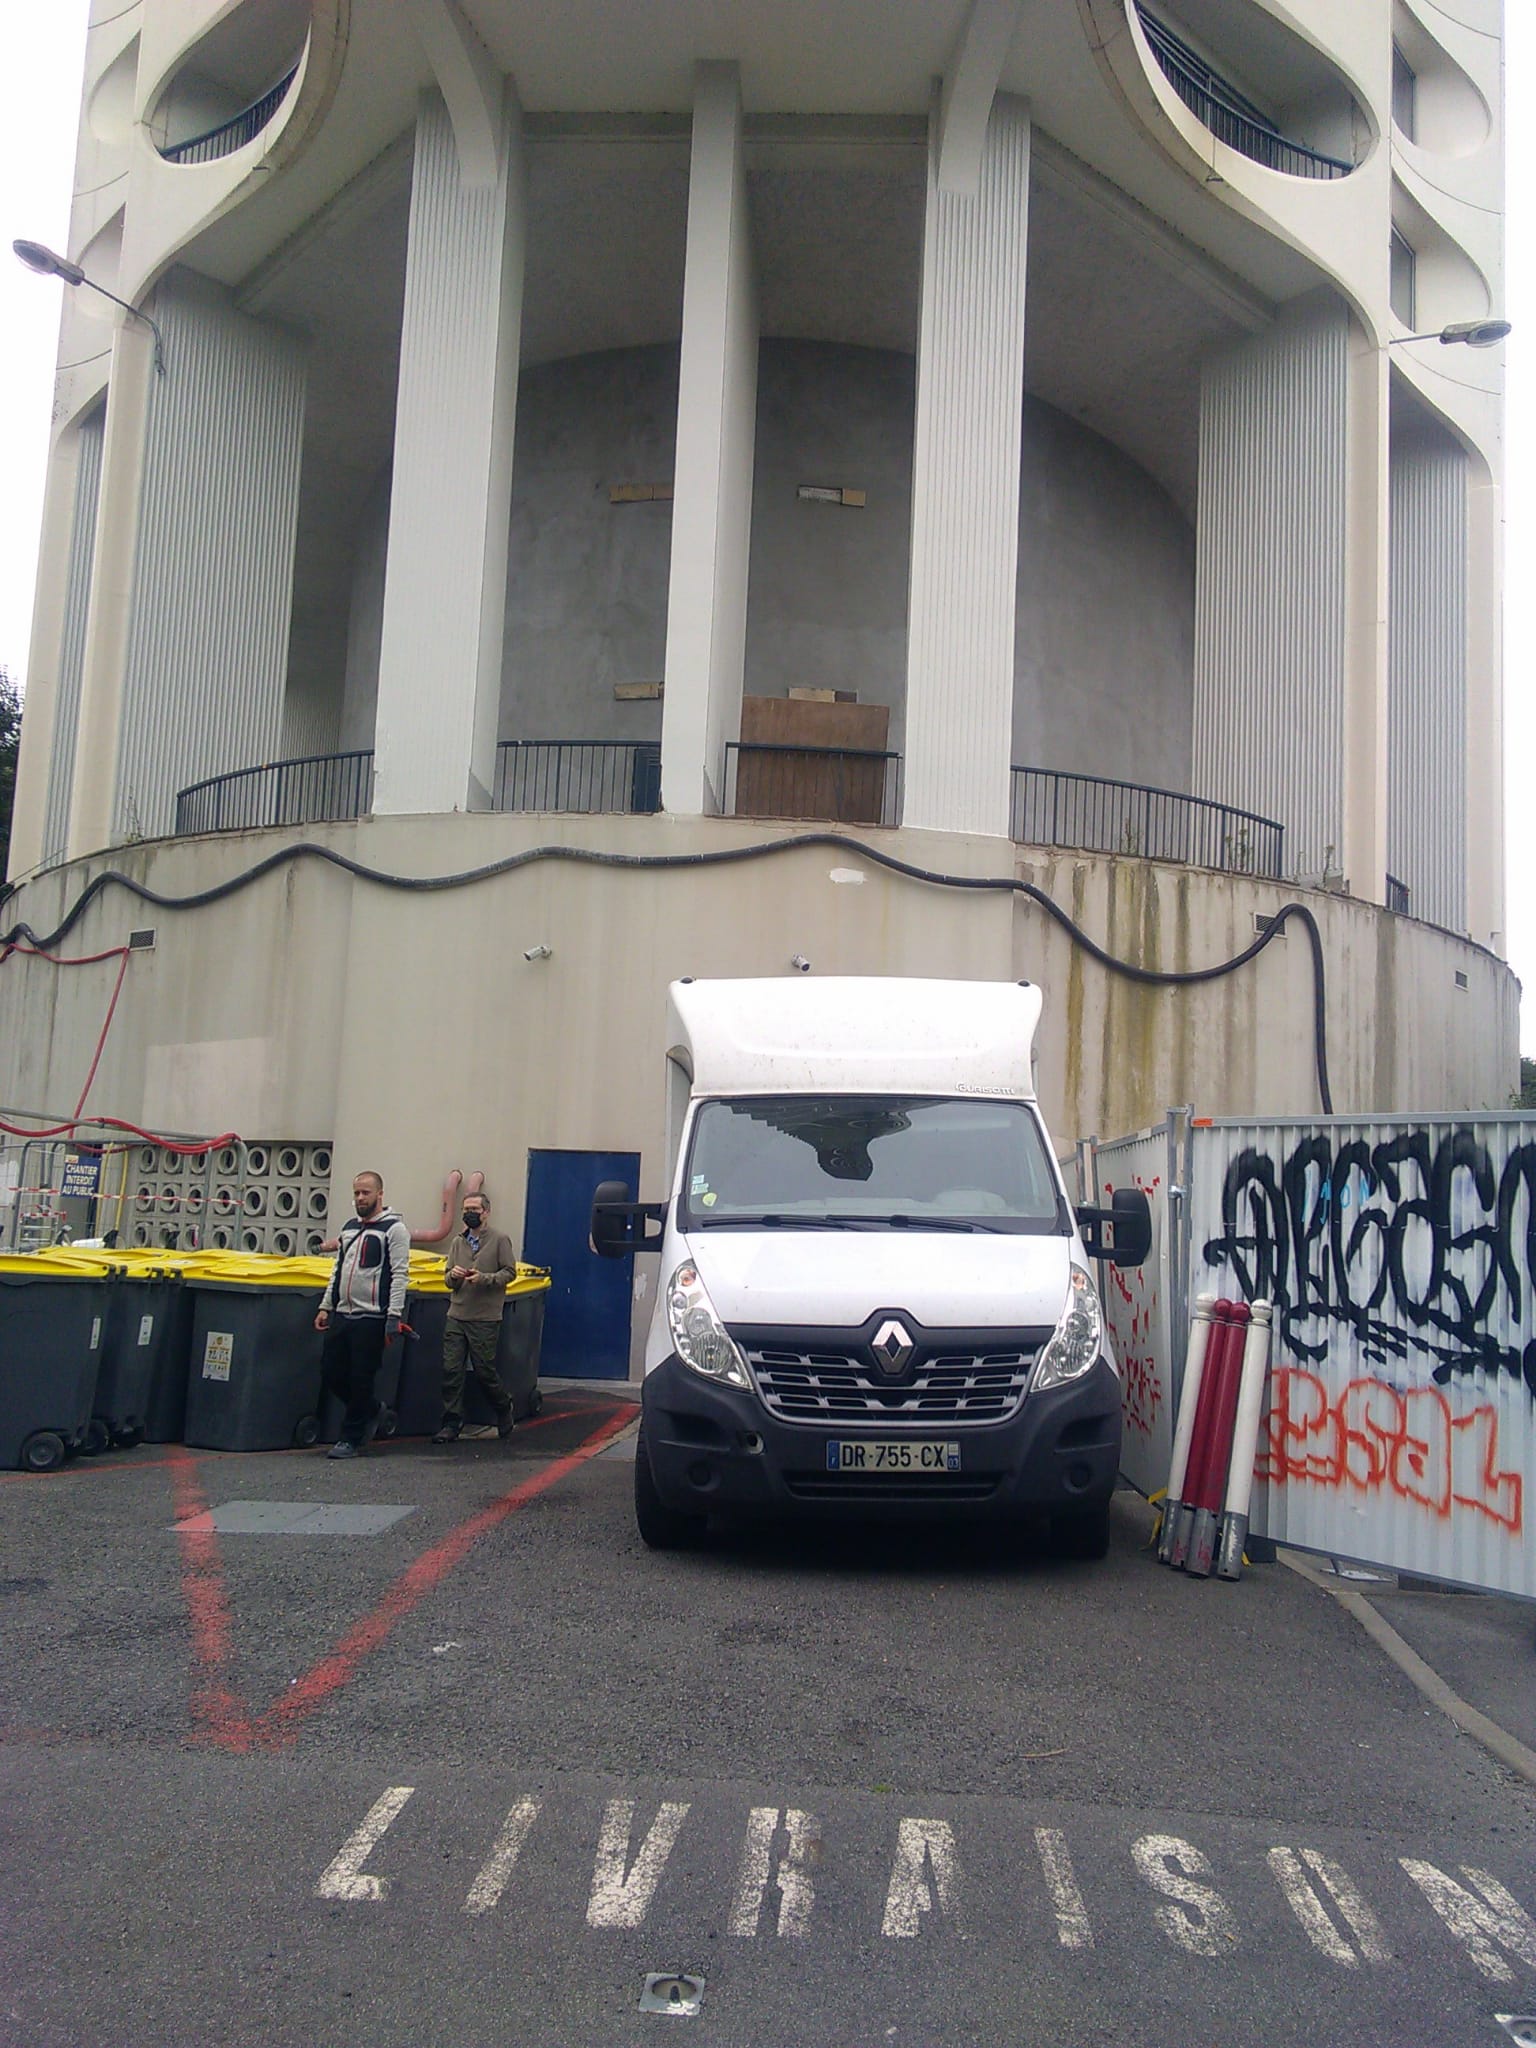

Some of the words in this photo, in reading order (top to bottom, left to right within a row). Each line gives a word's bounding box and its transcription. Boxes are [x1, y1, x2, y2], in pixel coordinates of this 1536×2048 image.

[66, 1164, 98, 1175] CHANTIER
[66, 1175, 94, 1185] INTERDIT
[61, 1185, 72, 1195] AU
[72, 1186, 95, 1196] PUBLIC
[842, 1445, 944, 1467] DR-755-CX
[313, 1786, 1535, 1983] LIVRAISON
